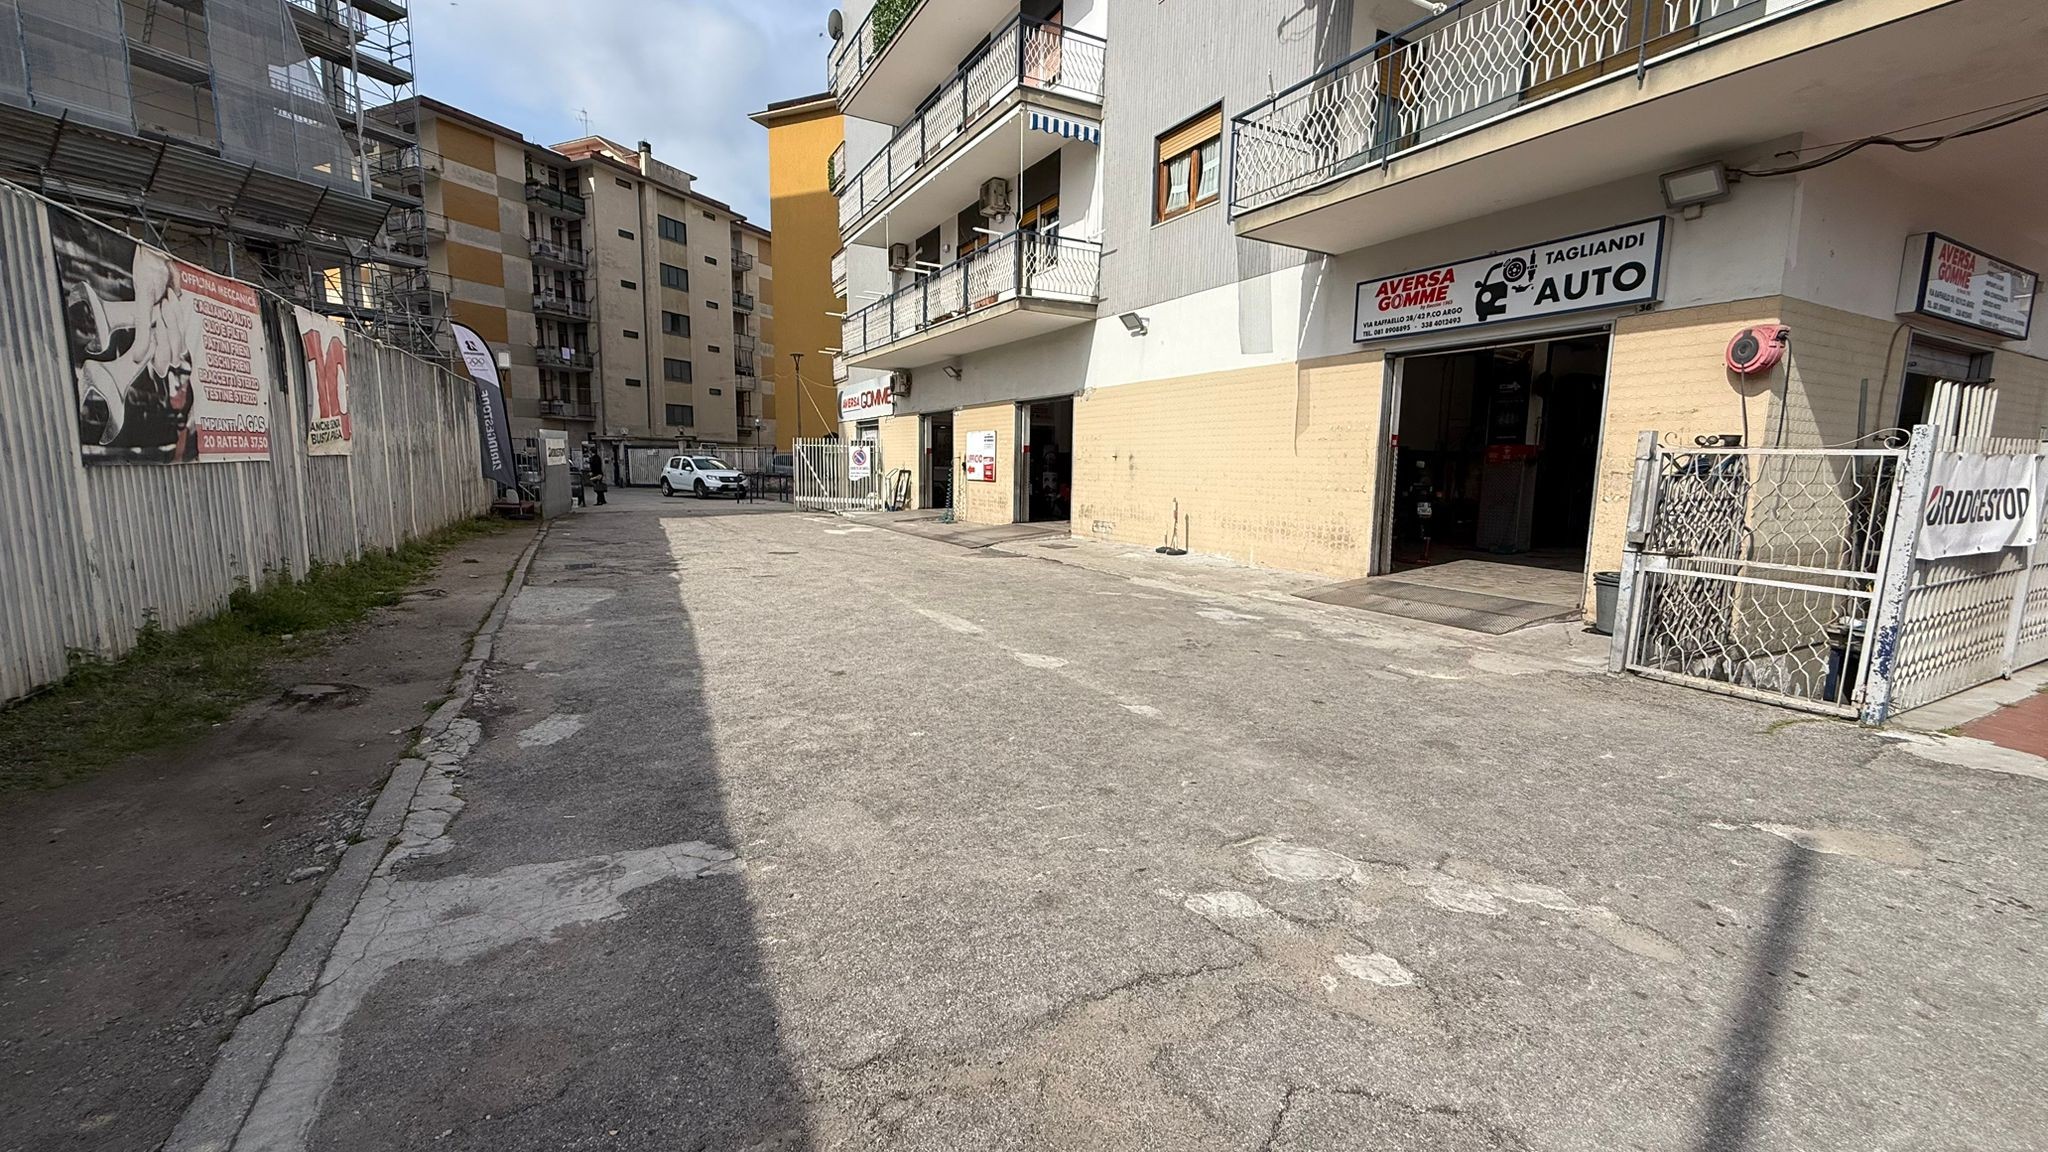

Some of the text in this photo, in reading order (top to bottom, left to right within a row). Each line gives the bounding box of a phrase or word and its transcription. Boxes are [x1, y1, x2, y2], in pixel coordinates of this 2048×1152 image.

[1545, 232, 1645, 265] TAGLIANDI
[1938, 243, 1976, 273] AVERSA
[1375, 267, 1455, 298] AVERSA
[1534, 261, 1647, 306] AUTO
[1938, 261, 1972, 290] GOMME
[1378, 285, 1450, 312] GOMME
[1363, 321, 1373, 329] VIA
[1374, 316, 1405, 327] RAFFAELLO
[1442, 307, 1463, 316] ARGO
[237, 414, 245, 432] A
[246, 415, 266, 434] GAS
[203, 435, 215, 448] 20
[217, 435, 238, 448] RATE
[239, 436, 249, 448] DA
